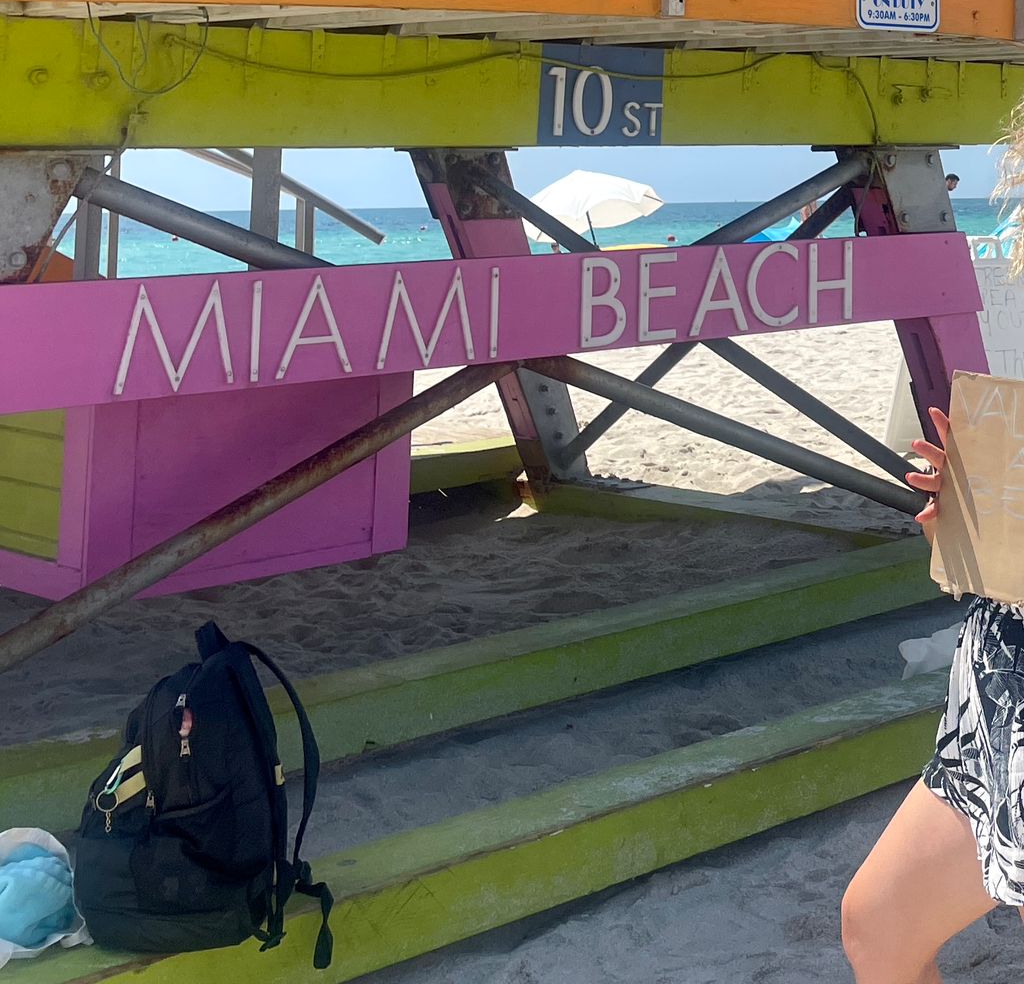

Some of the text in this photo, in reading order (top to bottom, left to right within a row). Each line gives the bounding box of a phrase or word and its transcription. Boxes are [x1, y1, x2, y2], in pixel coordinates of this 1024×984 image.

[868, 10, 896, 20] 9:30AM
[904, 12, 930, 22] 6:30PM
[548, 66, 664, 137] 10 ST
[113, 240, 854, 396] MIAMI BEACH
